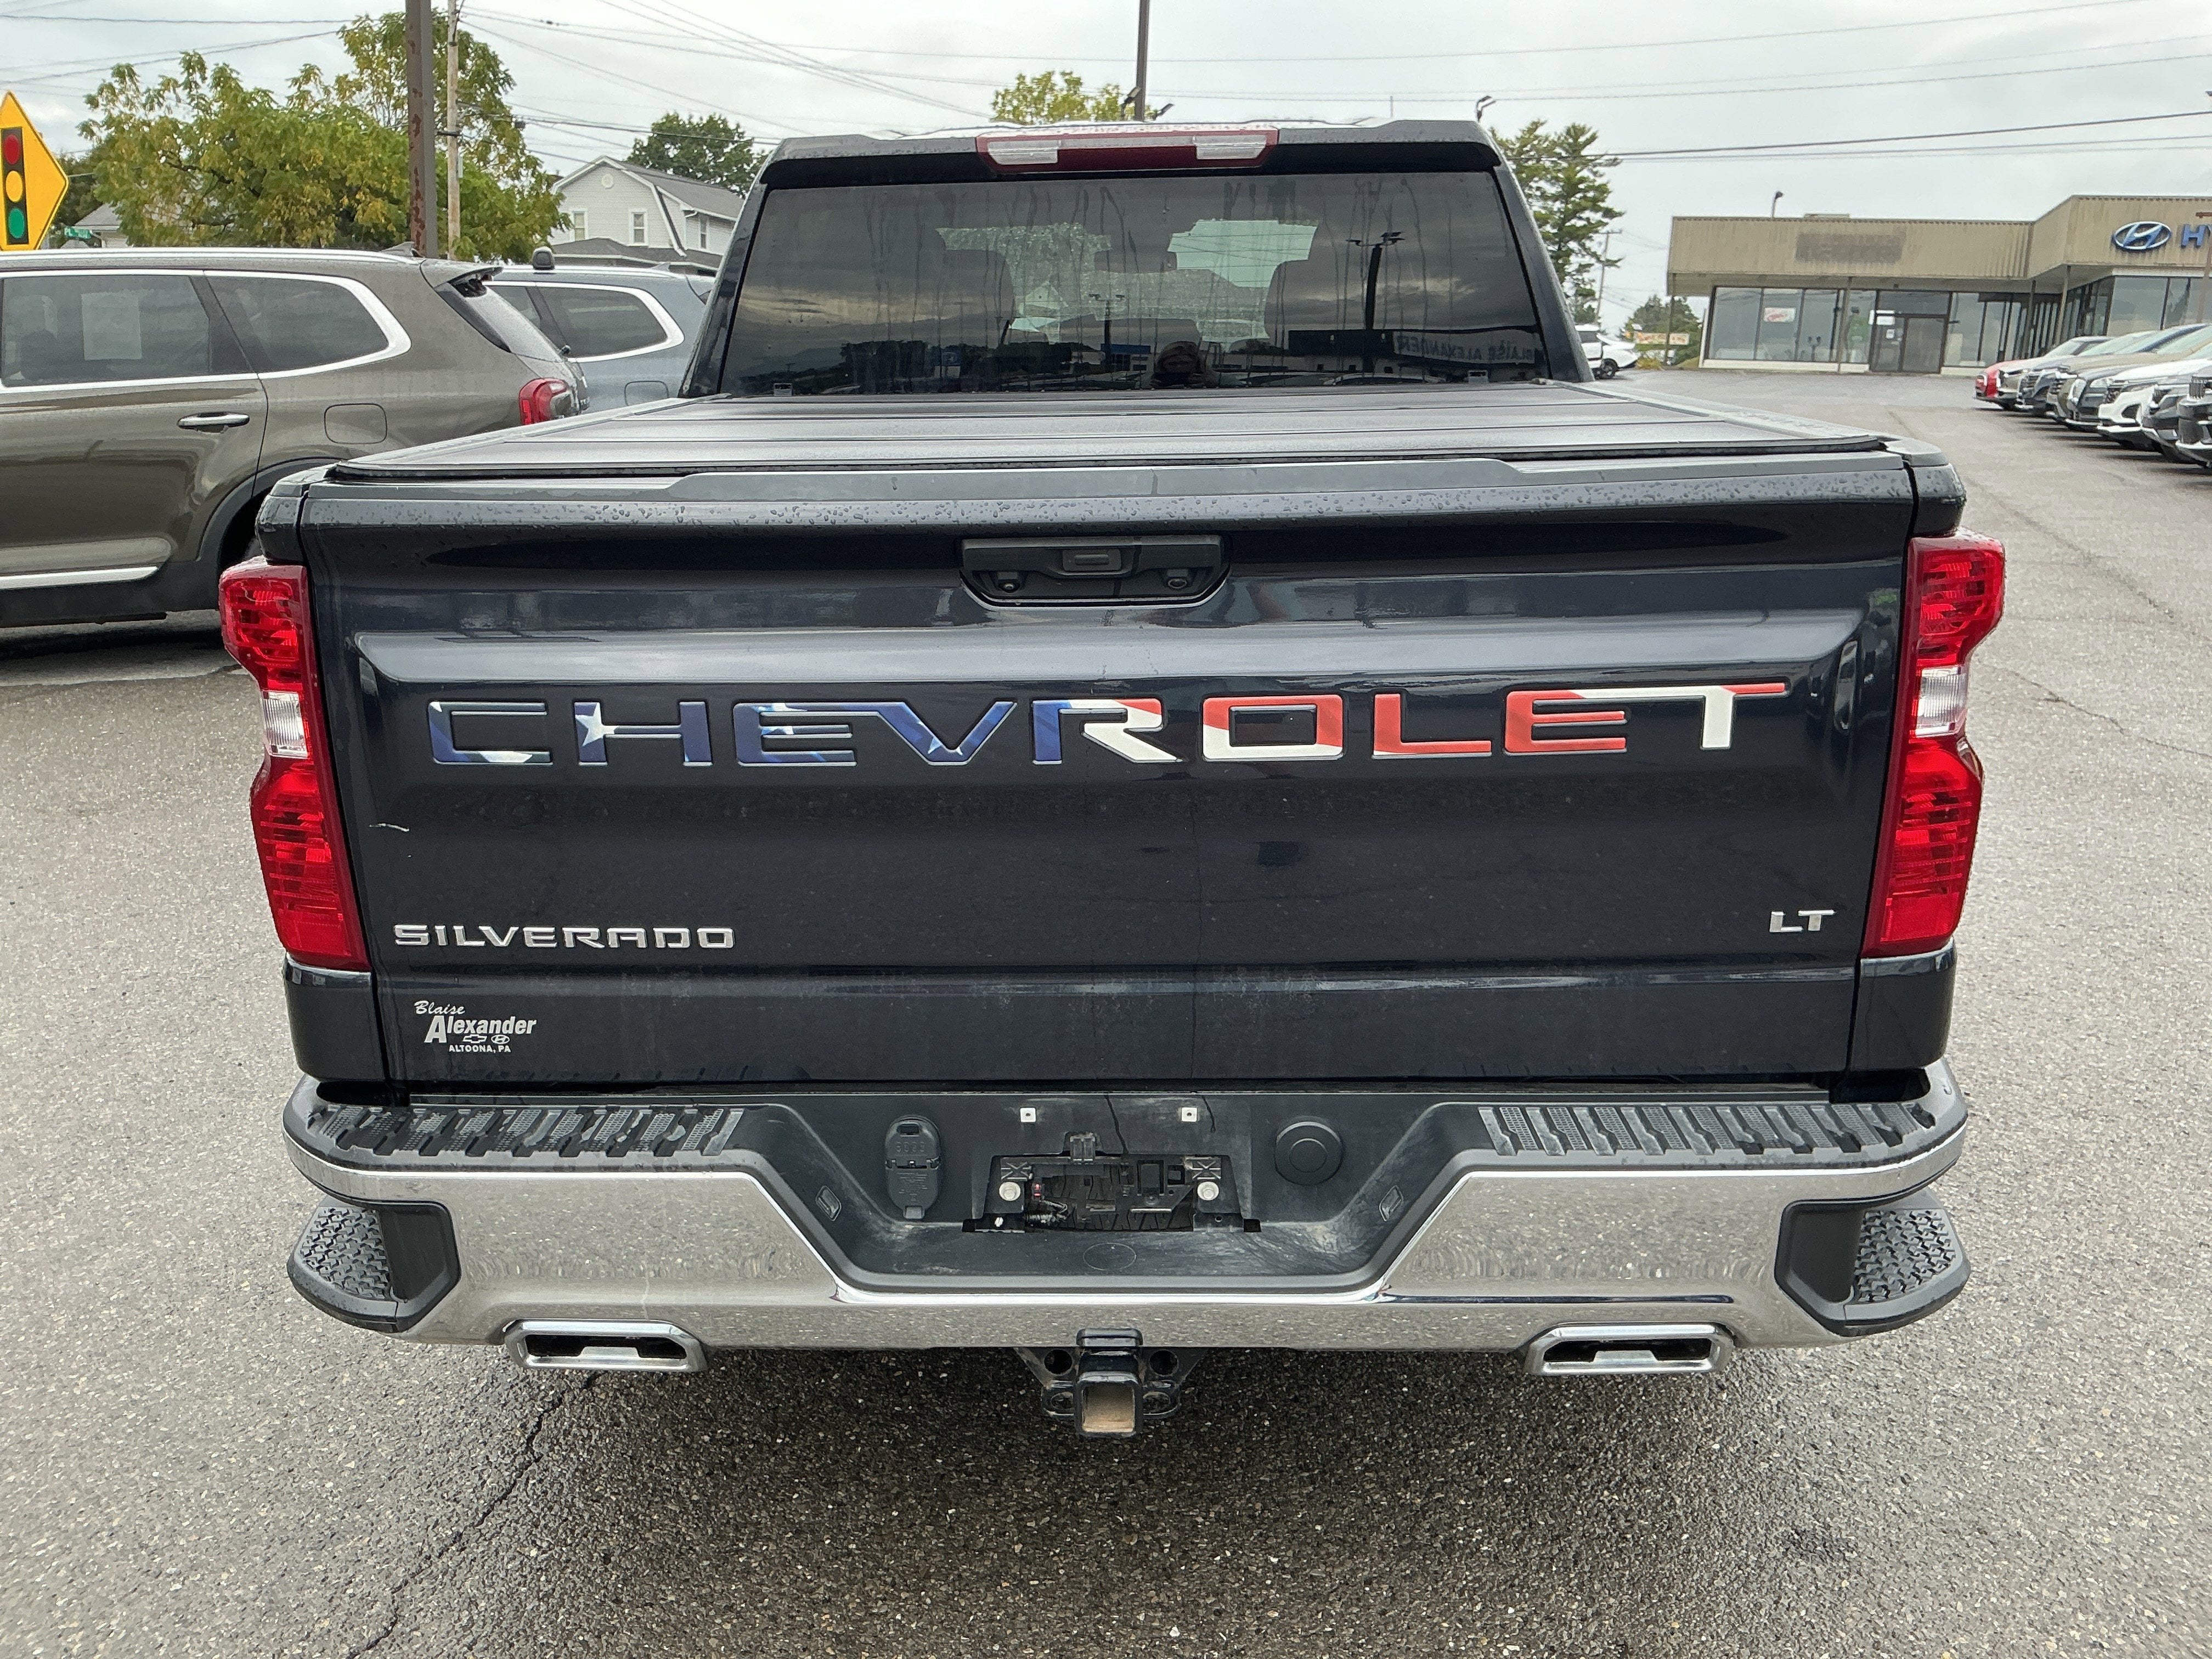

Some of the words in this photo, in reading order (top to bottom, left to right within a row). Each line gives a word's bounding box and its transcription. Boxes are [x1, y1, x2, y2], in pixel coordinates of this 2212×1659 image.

[2181, 223, 2212, 249] H
[427, 682, 1788, 767] CHEVROLET
[1769, 909, 1836, 933] LT
[393, 924, 735, 949] SILVERADO
[414, 1000, 465, 1014] Blaise
[424, 1015, 537, 1043] Alexander
[448, 1045, 496, 1053] ALTOONA,
[498, 1045, 511, 1053] PA
